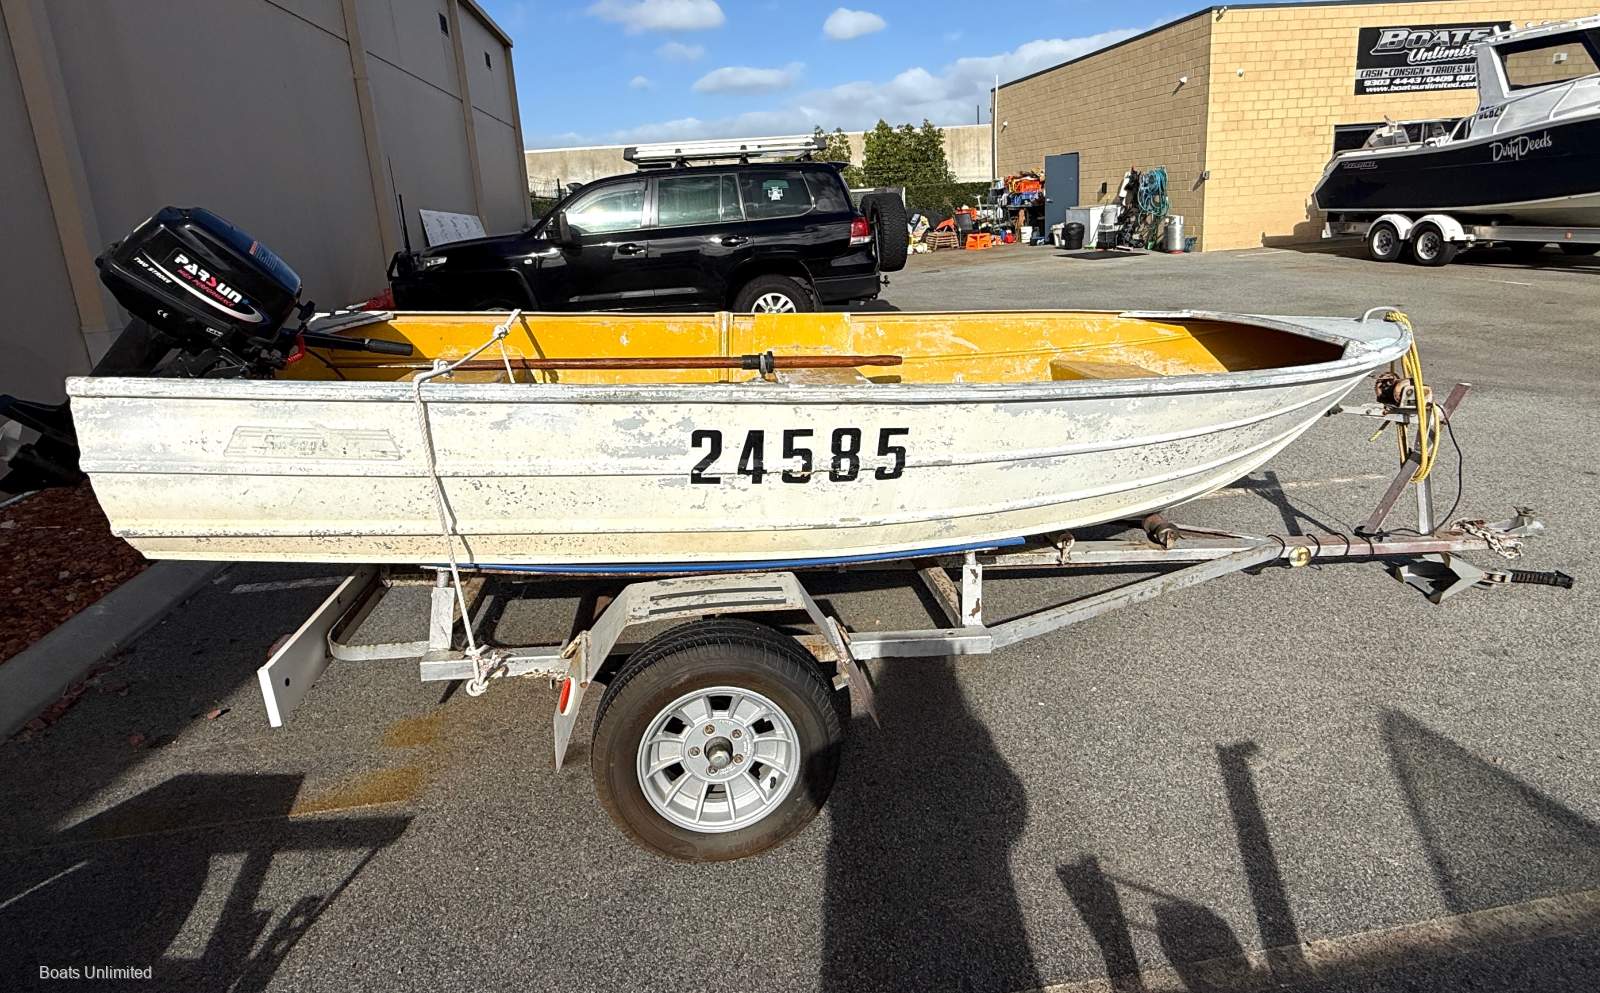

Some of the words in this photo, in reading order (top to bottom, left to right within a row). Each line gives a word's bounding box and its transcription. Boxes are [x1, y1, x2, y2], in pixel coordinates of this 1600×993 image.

[1360, 69, 1383, 78] CASH
[1388, 67, 1425, 77] CONSIGN
[1431, 64, 1463, 75] TRADES
[1363, 78, 1390, 87] 9303
[1519, 131, 1552, 156] Deeds
[690, 427, 910, 484] 24585
